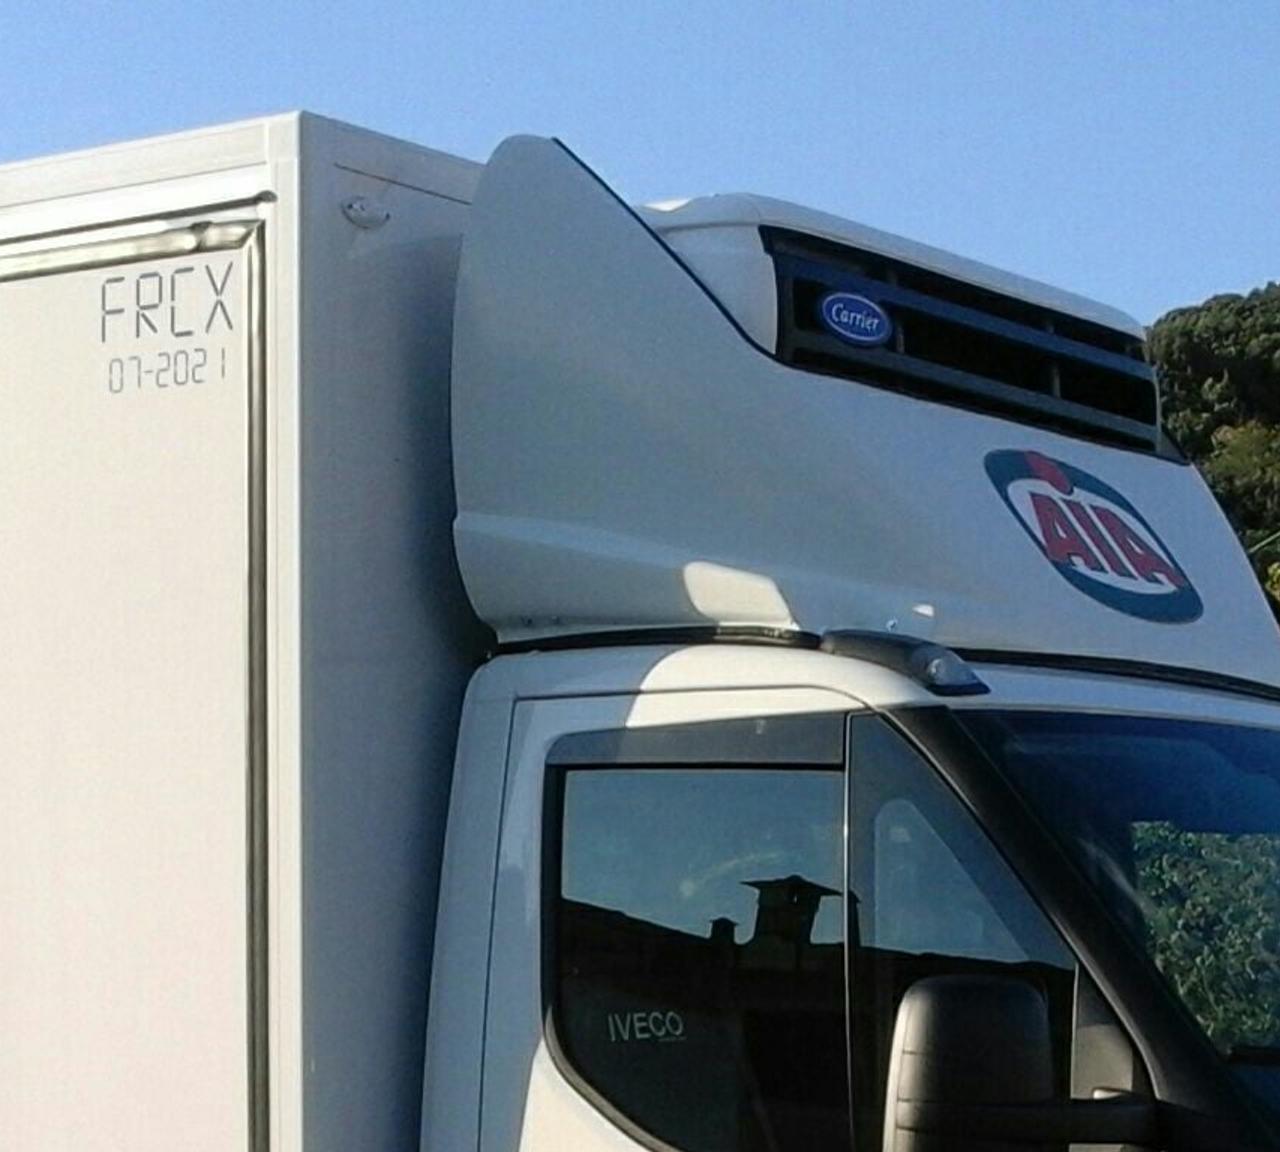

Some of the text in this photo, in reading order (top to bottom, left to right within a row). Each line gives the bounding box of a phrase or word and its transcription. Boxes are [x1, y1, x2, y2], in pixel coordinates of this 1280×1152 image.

[100, 261, 234, 344] FRCX
[831, 302, 881, 332] Carrier
[108, 347, 226, 394] 07-2021
[1029, 490, 1187, 590] AIA
[607, 1010, 685, 1042] IVECO
